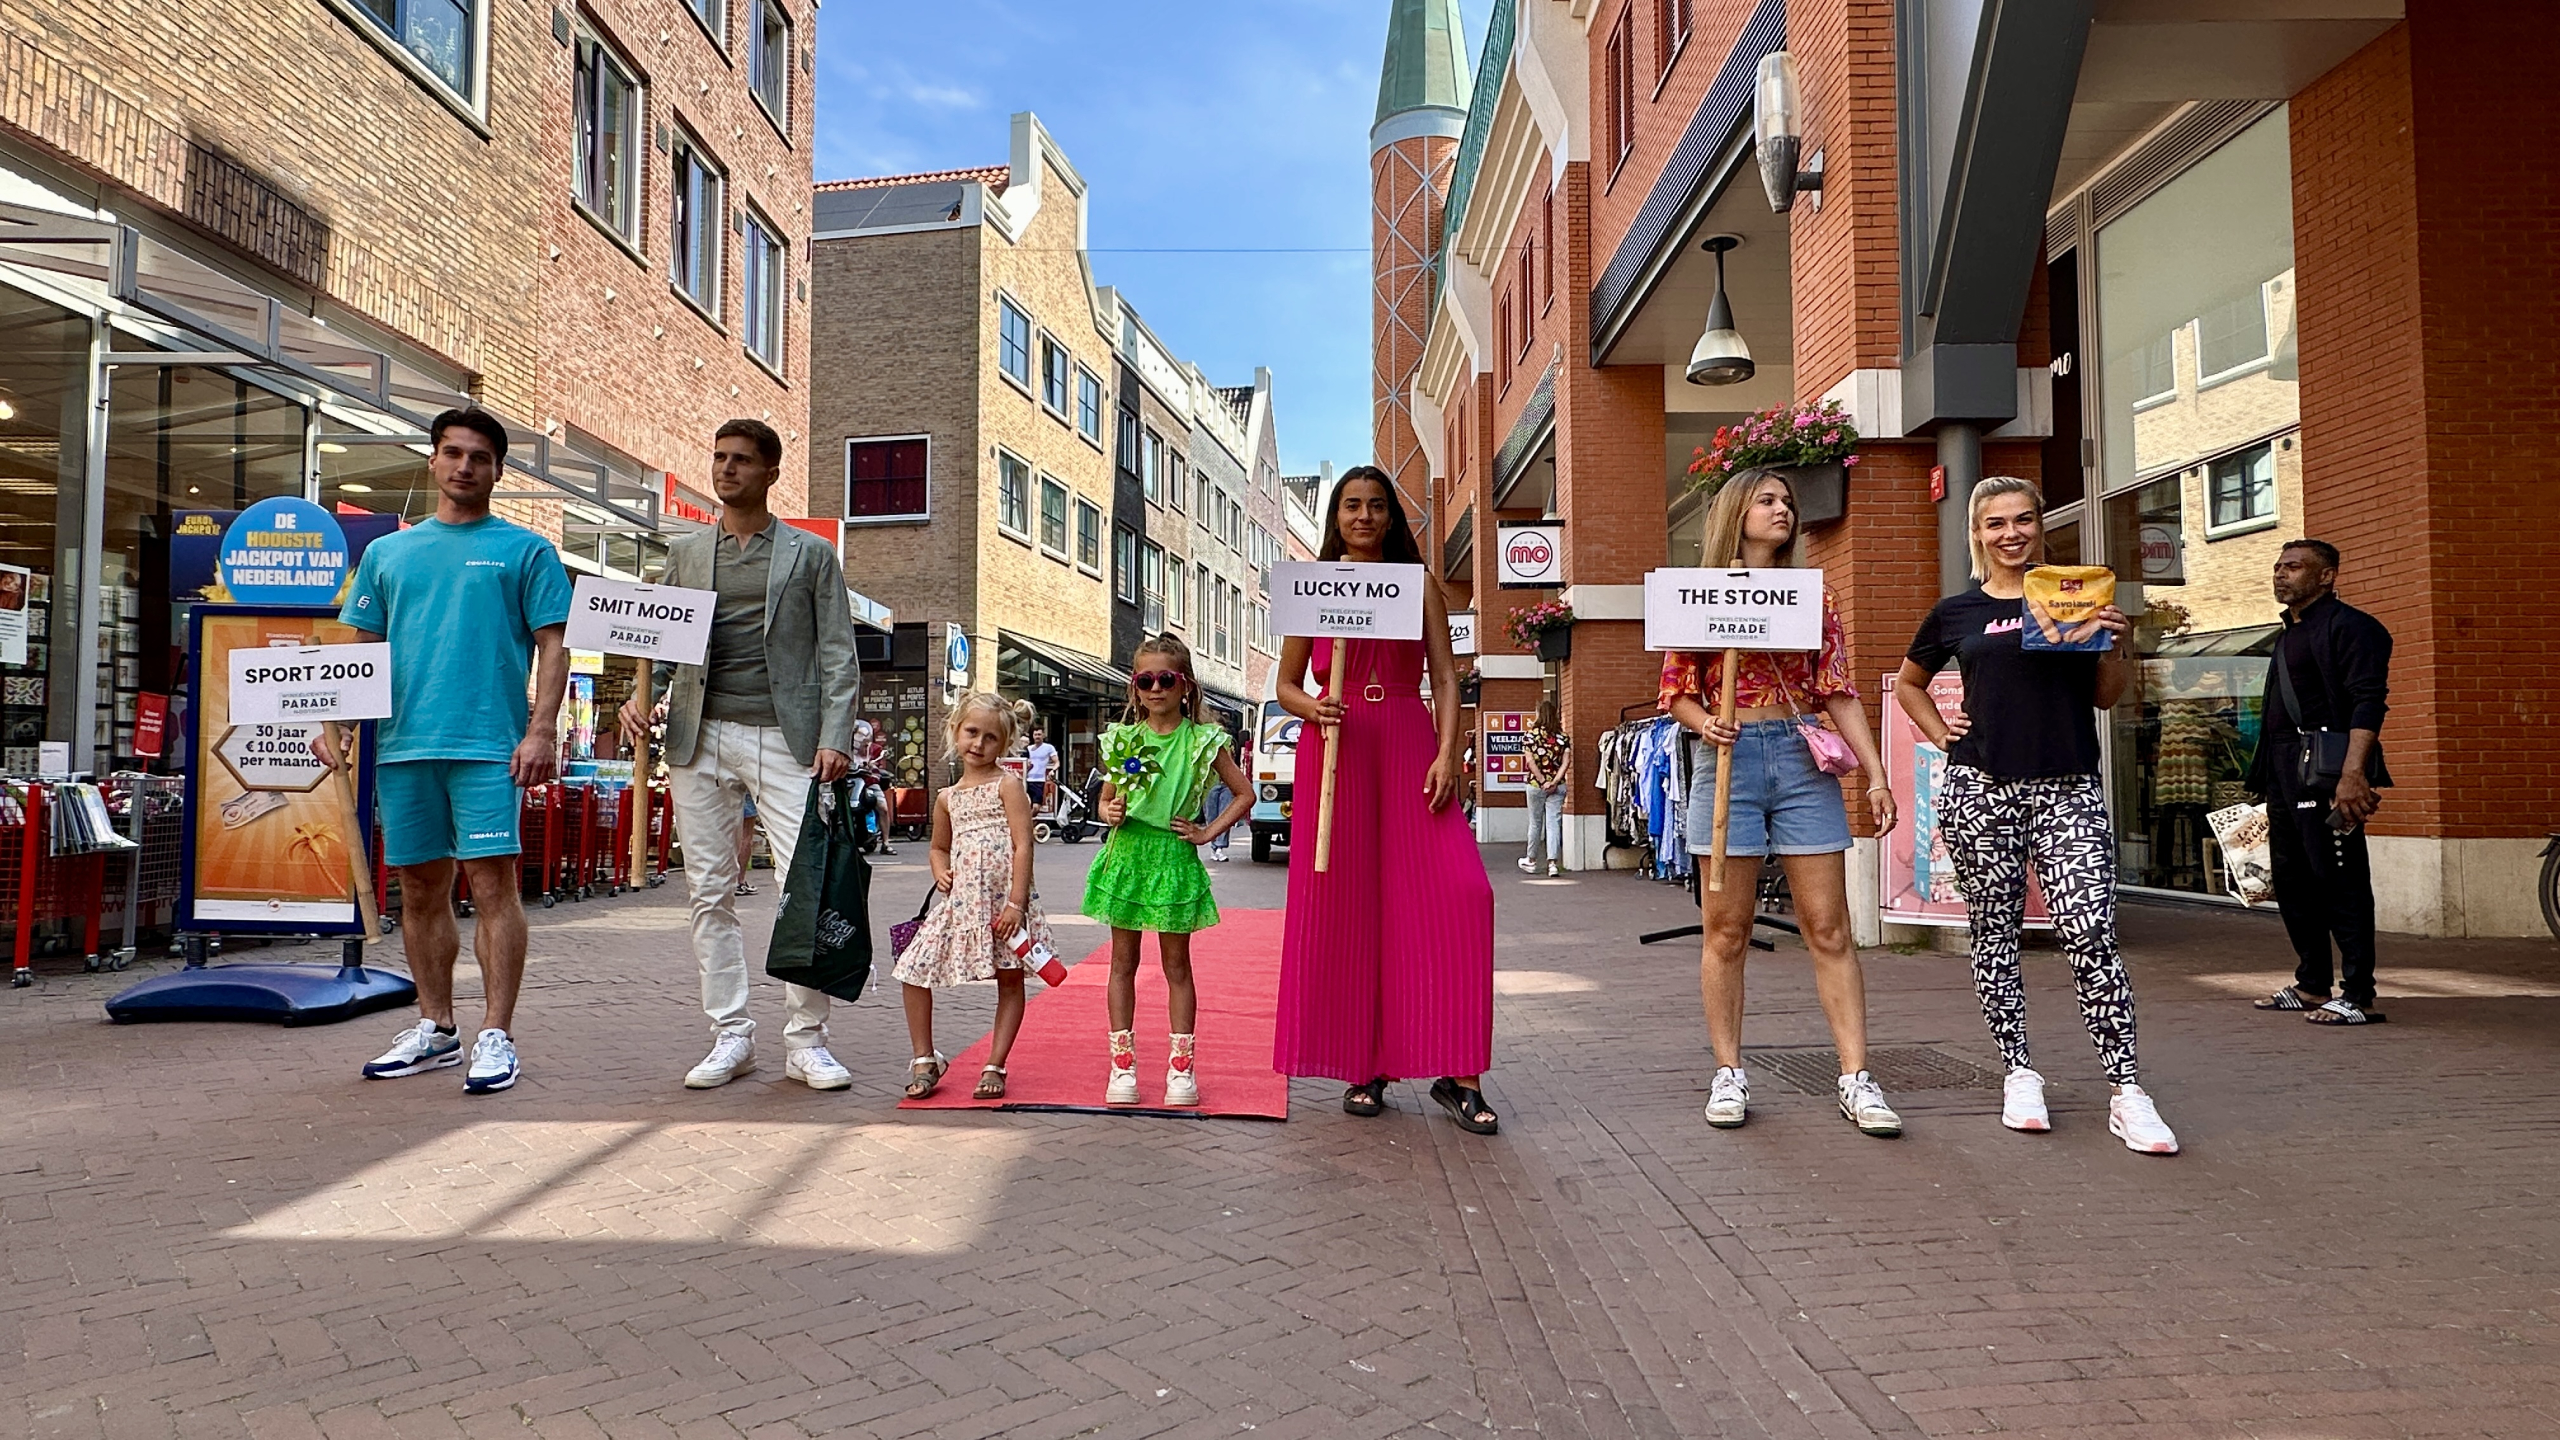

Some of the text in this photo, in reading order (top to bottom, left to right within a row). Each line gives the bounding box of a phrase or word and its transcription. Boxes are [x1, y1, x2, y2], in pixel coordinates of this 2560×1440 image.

[275, 513, 296, 529] DE
[176, 524, 221, 535] JACKPOT
[246, 532, 323, 548] HOOGSTE
[225, 550, 343, 567] JACKPOT VAN
[233, 569, 334, 587] NEDERLAND!
[1294, 581, 1400, 598] LUCKY MO
[1678, 589, 1798, 606] THE STONE
[588, 596, 694, 623] SMIT MODE
[1319, 615, 1373, 625] PARADE
[1709, 623, 1767, 634] PARADE
[609, 630, 659, 645] PARADE
[245, 662, 374, 684] SPORT 2000
[282, 697, 338, 709] PARADE
[256, 725, 307, 740] 30 jaar
[245, 741, 254, 752] €
[239, 756, 321, 768] per maand
